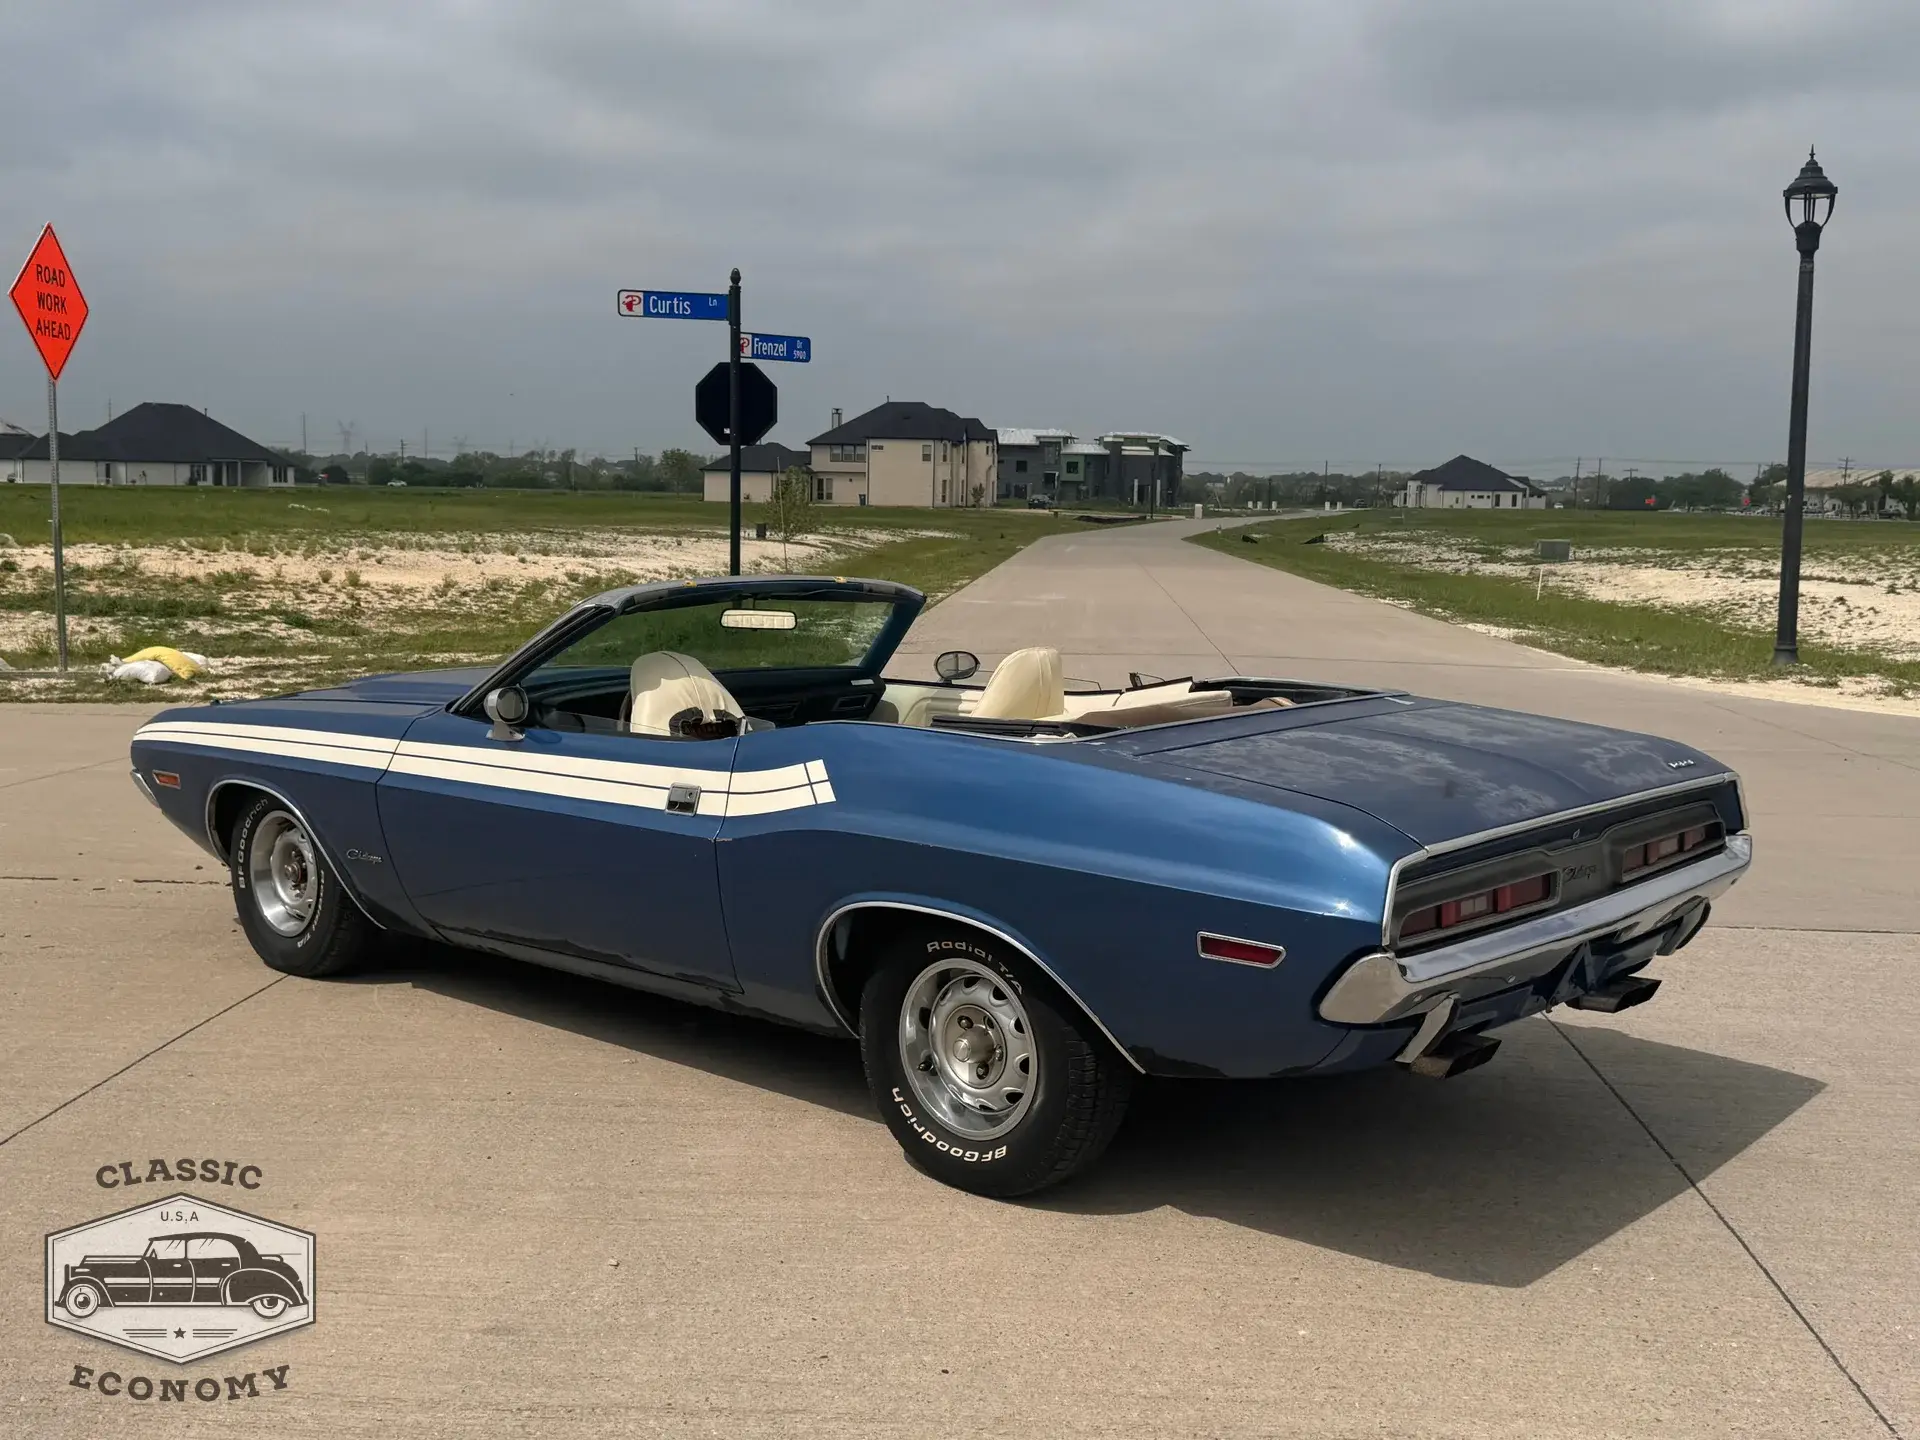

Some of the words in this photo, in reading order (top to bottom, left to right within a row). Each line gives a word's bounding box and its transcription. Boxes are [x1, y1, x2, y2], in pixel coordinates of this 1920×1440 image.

[36, 263, 66, 288] ROAD
[36, 291, 67, 315] WORK
[649, 295, 691, 315] Curtis
[708, 297, 718, 306] Ln
[35, 317, 71, 341] AHEAD
[753, 337, 787, 357] Frenzel
[926, 940, 993, 962] Radial
[998, 961, 1024, 995] T/A
[891, 1086, 1008, 1163] BFGoodrich
